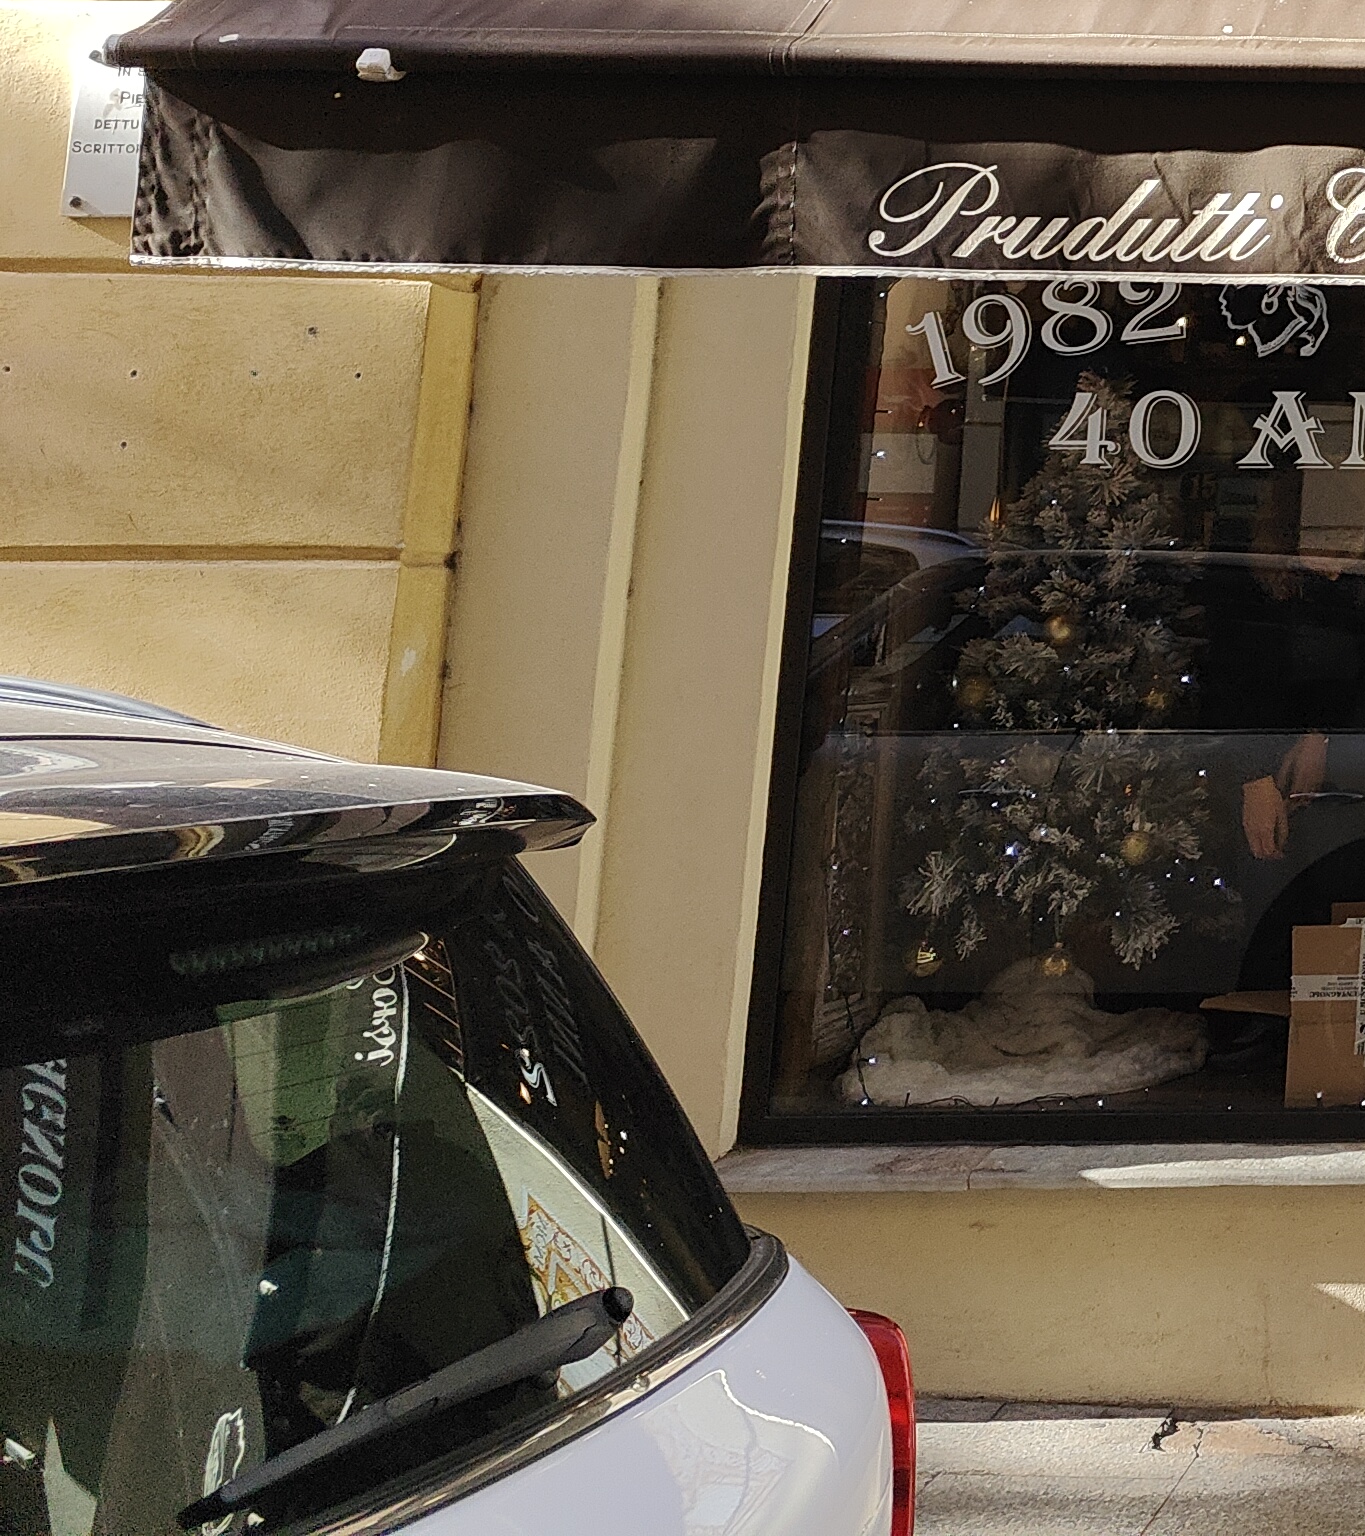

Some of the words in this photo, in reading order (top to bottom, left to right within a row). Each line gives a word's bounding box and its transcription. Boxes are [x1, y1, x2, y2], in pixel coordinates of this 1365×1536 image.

[867, 161, 1285, 264] Prudutti
[906, 280, 1189, 390] 1982
[1047, 388, 1203, 471] 40
